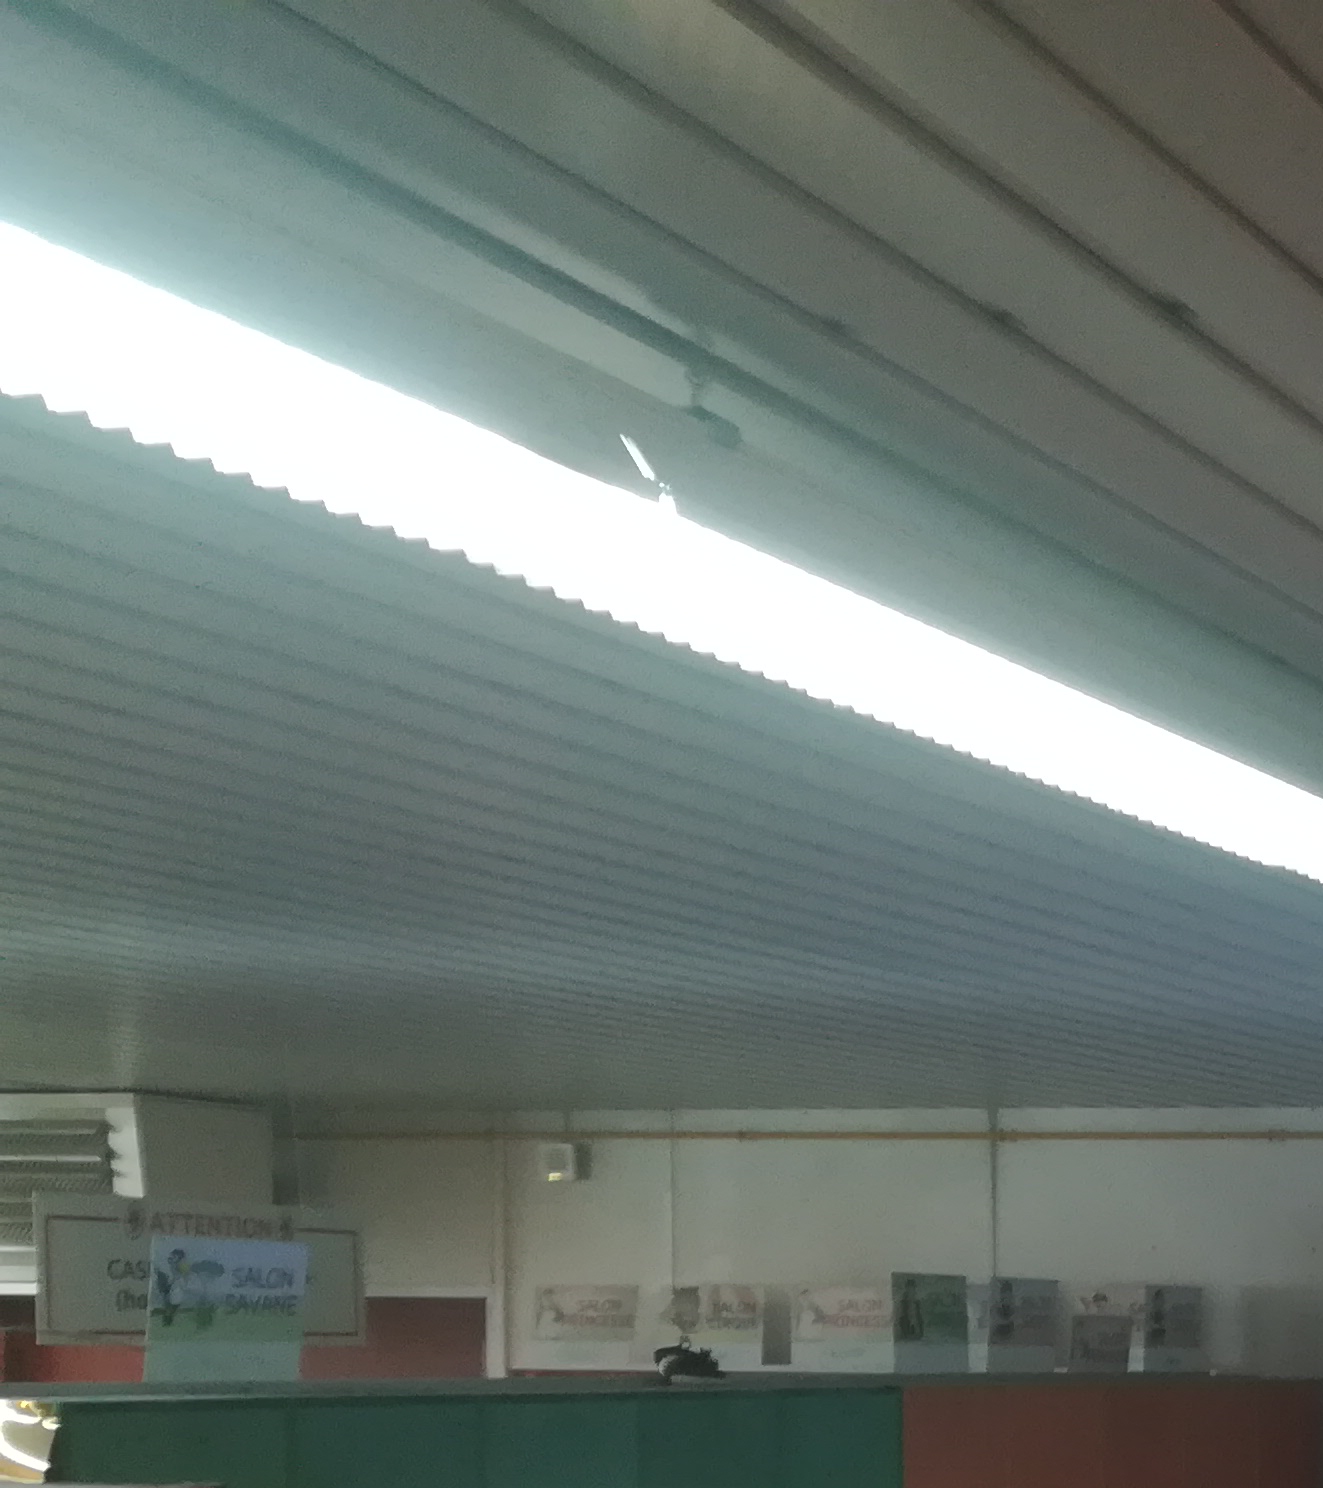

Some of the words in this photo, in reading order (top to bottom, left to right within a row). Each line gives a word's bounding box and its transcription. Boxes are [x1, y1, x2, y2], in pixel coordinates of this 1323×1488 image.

[150, 1211, 275, 1238] ATTENTION
[106, 1258, 148, 1281] CAS
[232, 1266, 295, 1289] SALON
[224, 1293, 298, 1317] SAVANE
